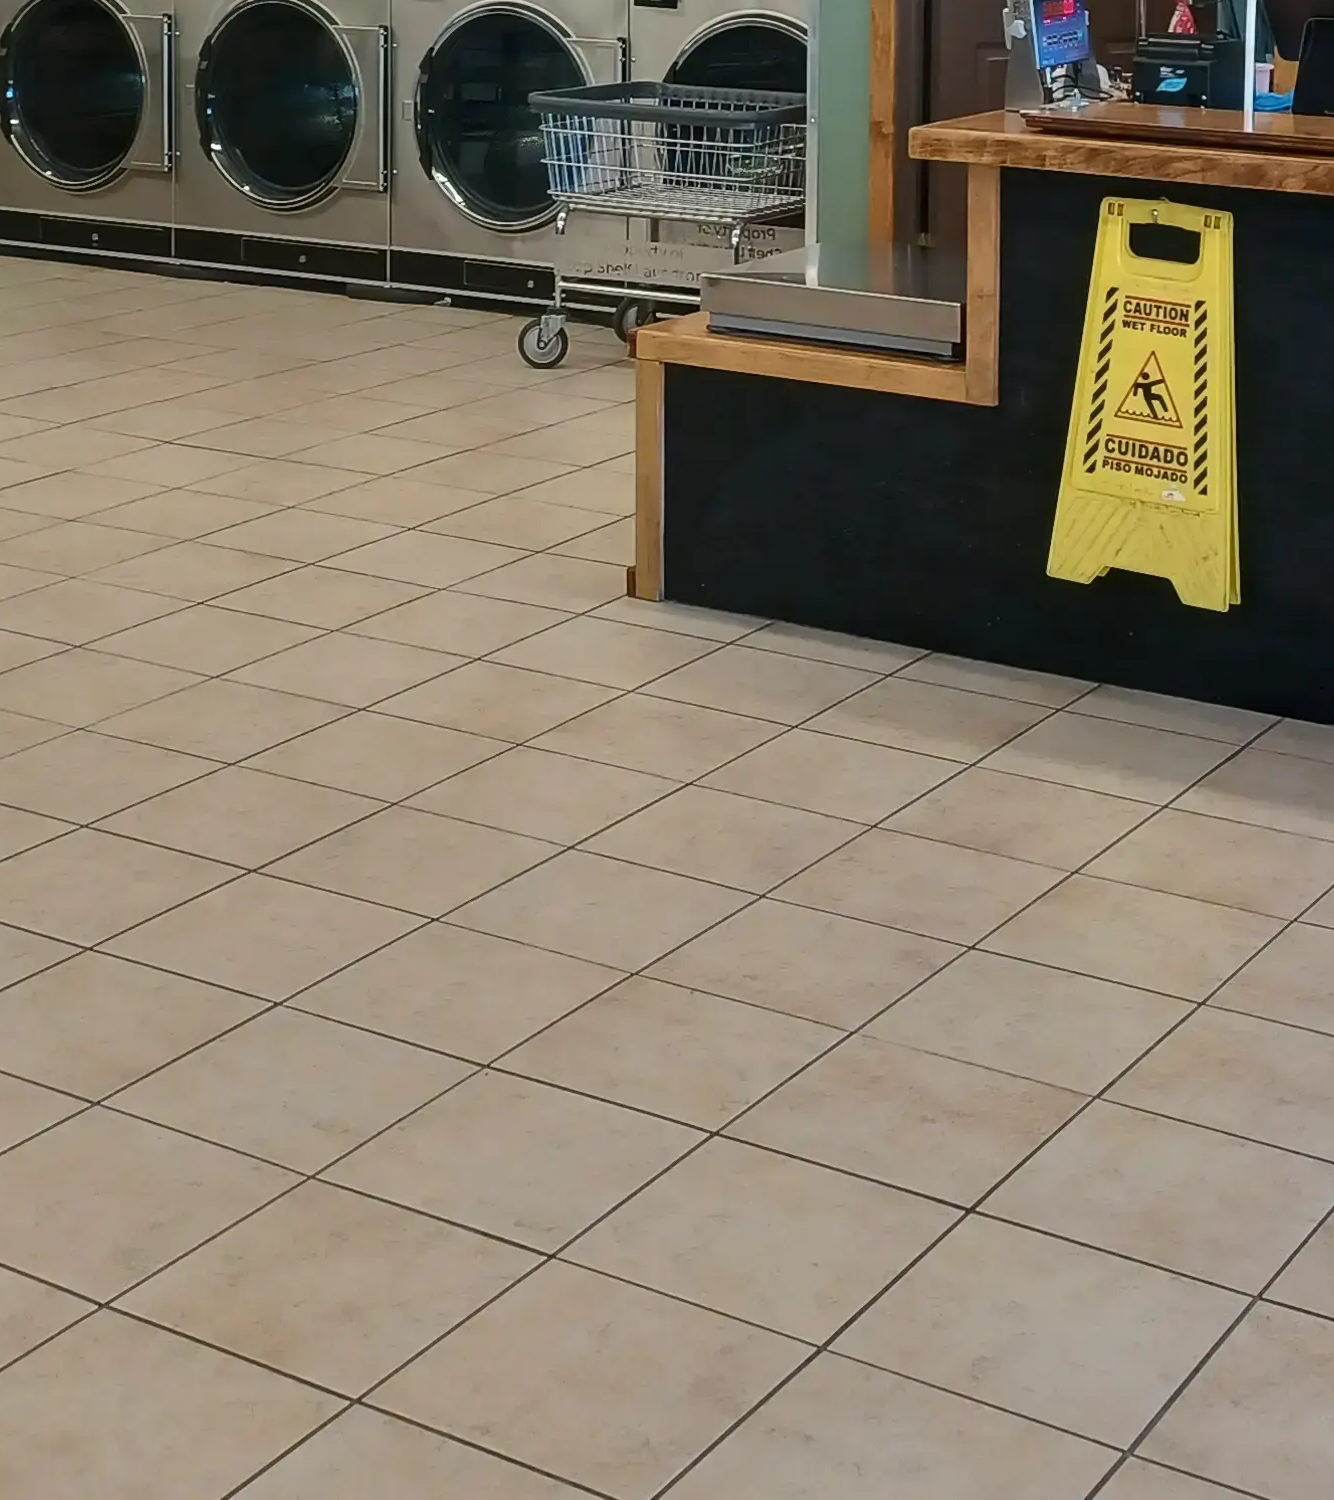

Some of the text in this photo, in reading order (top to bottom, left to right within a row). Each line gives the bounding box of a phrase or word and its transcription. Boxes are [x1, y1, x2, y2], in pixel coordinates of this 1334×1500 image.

[1123, 298, 1190, 323] CAUTION
[1122, 318, 1188, 339] WET FLOOR
[1103, 437, 1189, 467] CUIDADO
[1102, 459, 1188, 485] PISO MOJADO
